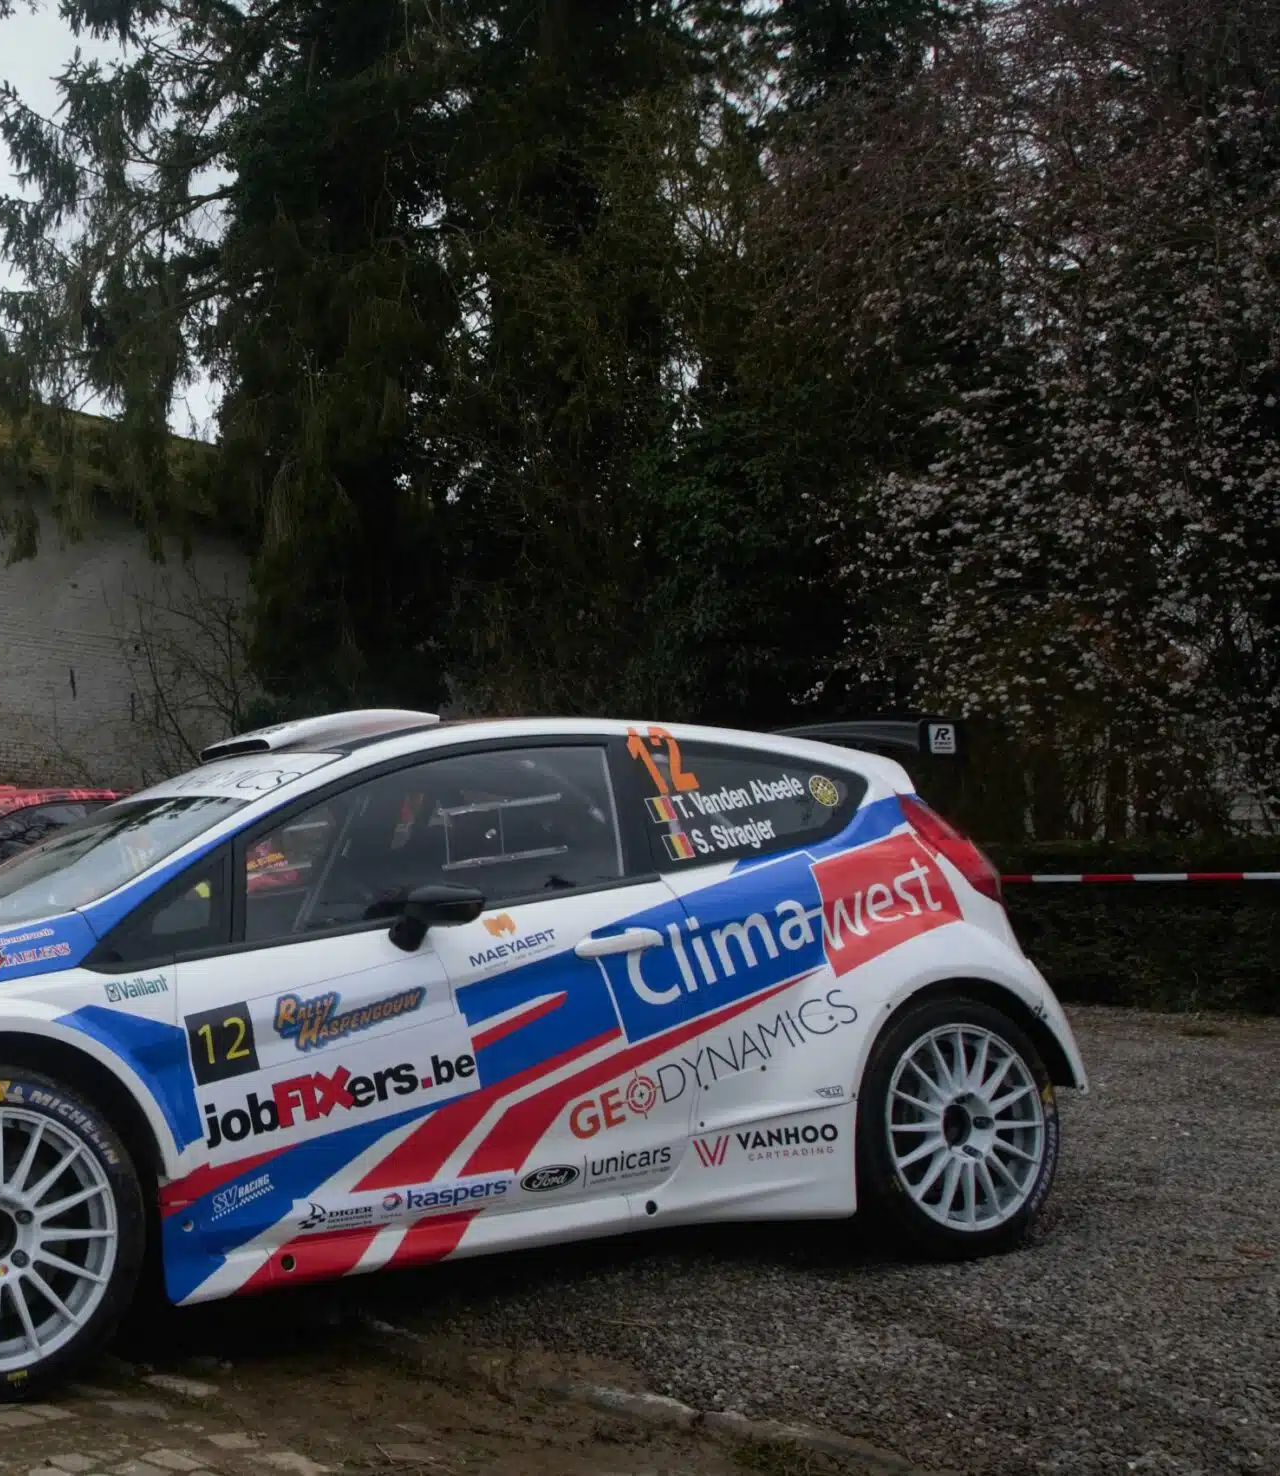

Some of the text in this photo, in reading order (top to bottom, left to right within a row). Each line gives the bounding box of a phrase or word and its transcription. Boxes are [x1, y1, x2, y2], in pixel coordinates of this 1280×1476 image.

[626, 726, 700, 795] 12
[672, 774, 805, 821] T. Vanden Abeele
[692, 818, 776, 854] S. Stragier
[469, 928, 556, 967] MAEYAERT
[120, 974, 168, 1001] Vaillant
[197, 1016, 250, 1065] 12
[29, 1090, 120, 1166] MICHELIN
[736, 1123, 839, 1151] VANHOO
[532, 1169, 568, 1189] Ford
[591, 1146, 671, 1176] unicars
[747, 1146, 835, 1162] CARTRADING
[237, 1174, 270, 1203] RACING
[407, 1178, 508, 1210] kaspers
[328, 1206, 373, 1218] DIGER
